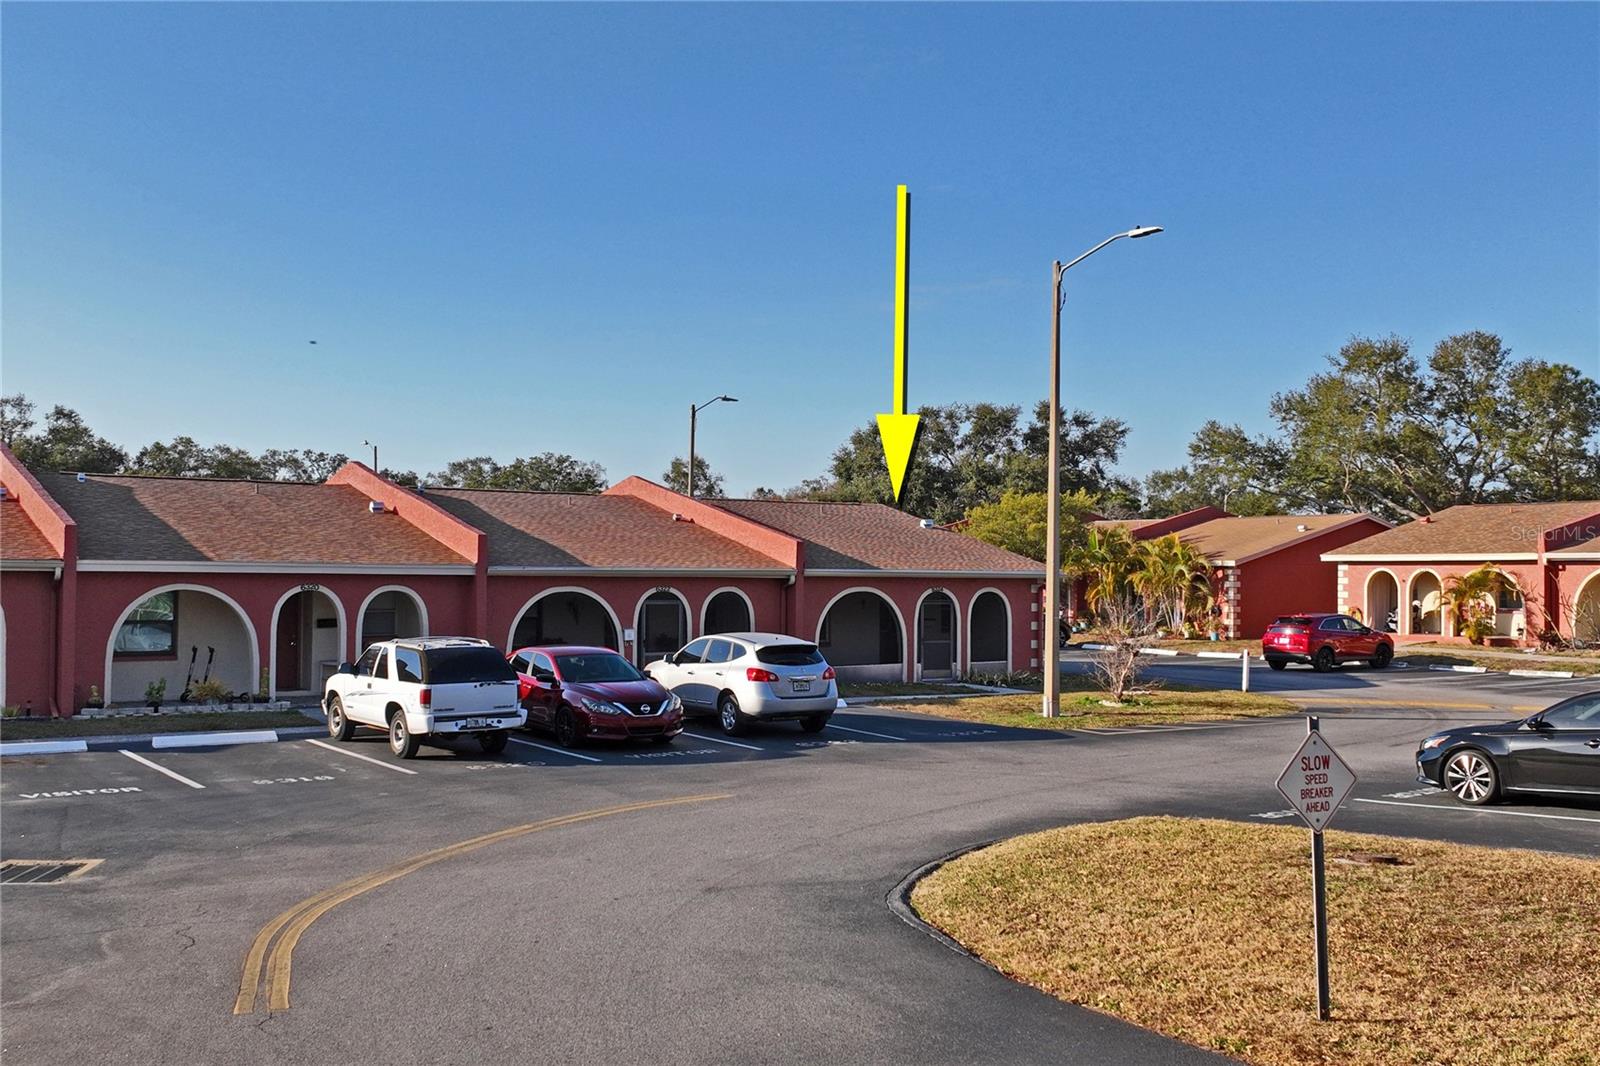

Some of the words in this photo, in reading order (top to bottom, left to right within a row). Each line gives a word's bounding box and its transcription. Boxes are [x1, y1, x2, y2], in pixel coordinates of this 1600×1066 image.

[1301, 755, 1331, 771] SLOW
[1305, 773, 1329, 785] SPEED
[19, 786, 143, 799] VISITOR
[1300, 786, 1334, 800] BREAKER
[1305, 801, 1330, 814] AHEAD
